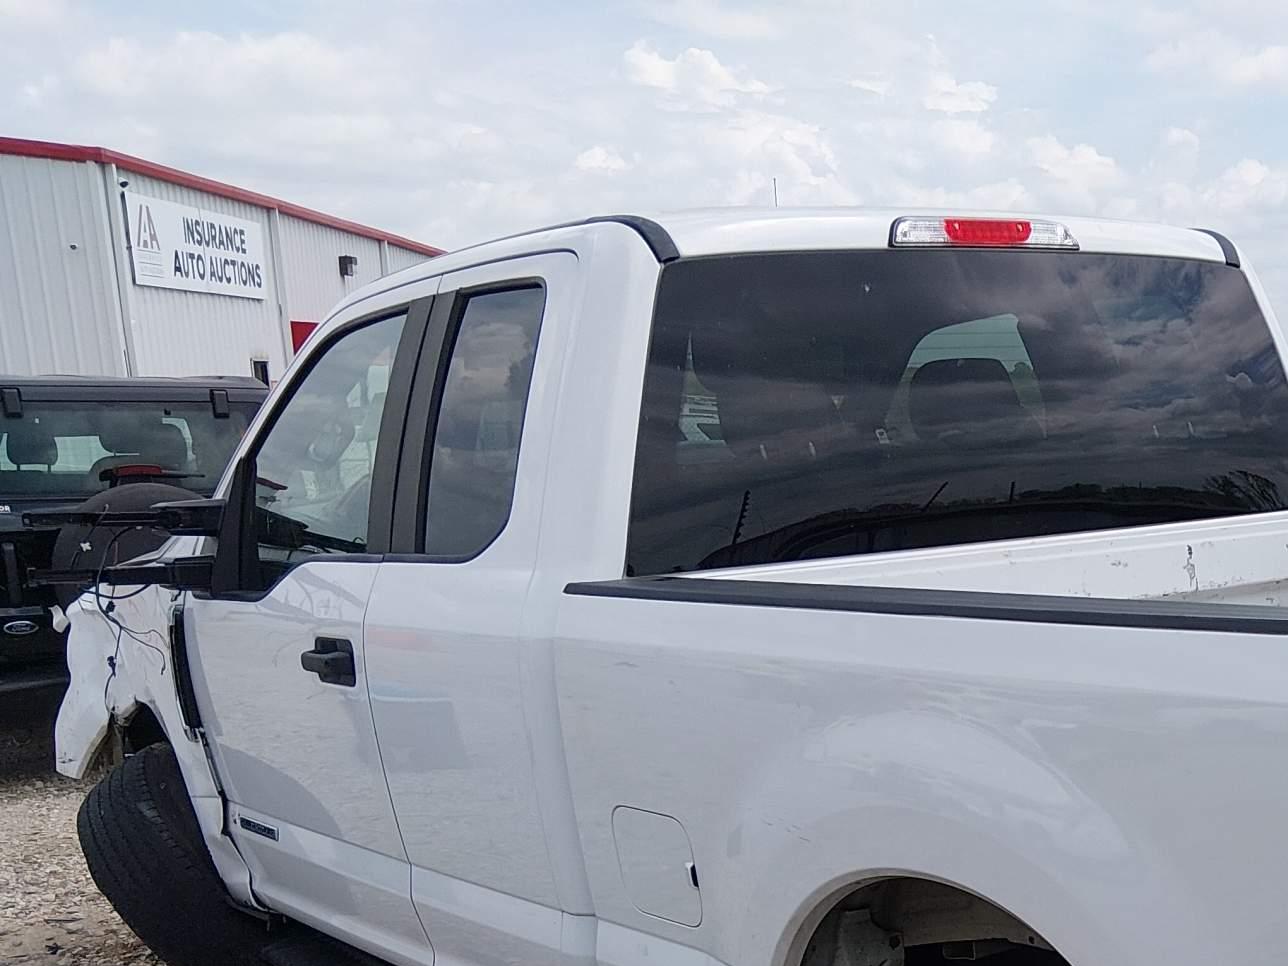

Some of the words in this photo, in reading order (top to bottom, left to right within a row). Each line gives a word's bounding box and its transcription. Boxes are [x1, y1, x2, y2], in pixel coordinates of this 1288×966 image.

[182, 216, 247, 255] INSURANCE
[173, 249, 206, 281] AUTO
[209, 257, 263, 289] AUCTIONS
